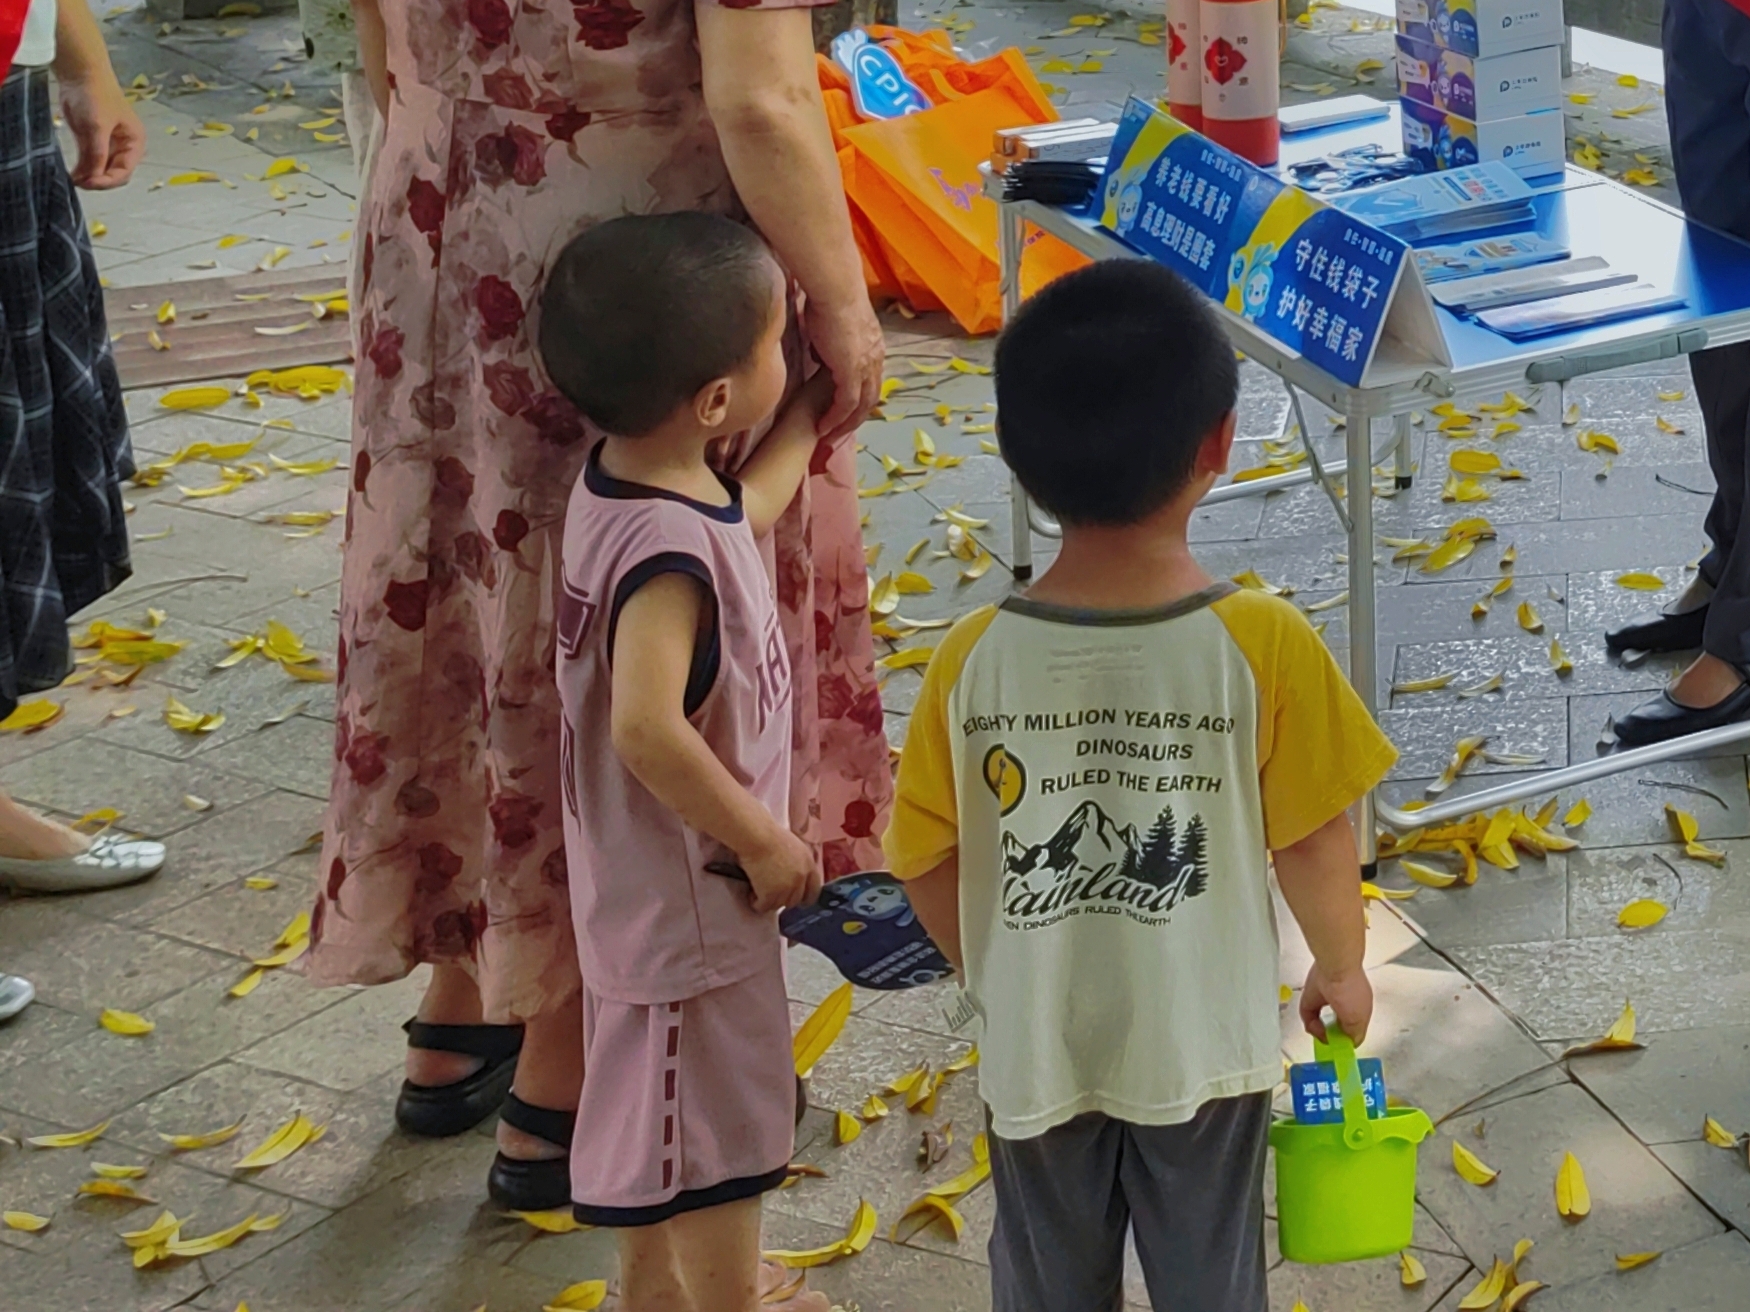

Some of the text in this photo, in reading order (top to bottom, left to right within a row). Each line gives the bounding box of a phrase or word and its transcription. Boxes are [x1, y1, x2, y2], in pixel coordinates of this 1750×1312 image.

[1156, 156, 1232, 225] 养老钱要看好
[1296, 238, 1382, 309] 守住钱袋子
[1278, 285, 1364, 363] 护好幸福家
[963, 708, 1235, 737] EIGHTY MILLION YEARS AGO
[1076, 738, 1194, 761] DINOSAURS
[1040, 769, 1223, 795] RULED THE EARTH
